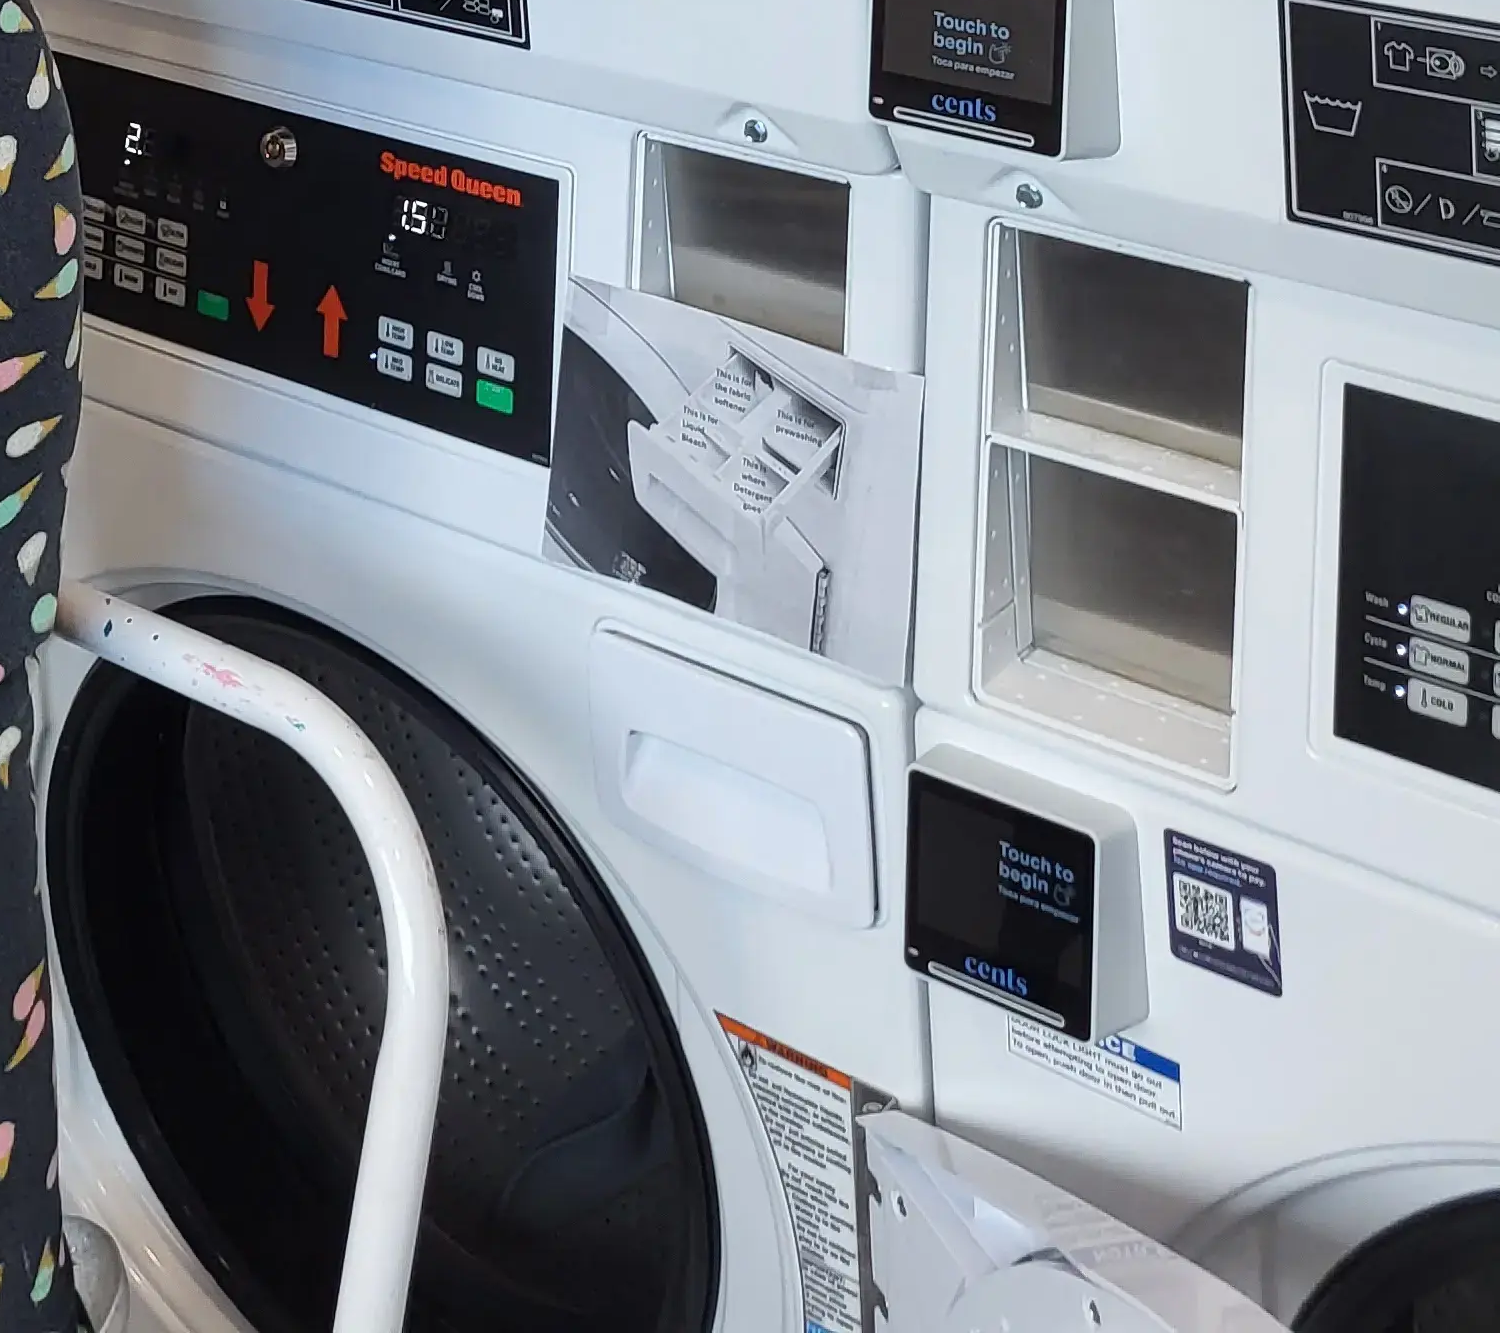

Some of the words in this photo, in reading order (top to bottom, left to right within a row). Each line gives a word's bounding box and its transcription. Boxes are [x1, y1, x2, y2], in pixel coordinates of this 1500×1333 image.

[933, 10, 987, 36] Touch
[989, 22, 1010, 40] to
[933, 30, 984, 56] begin
[931, 55, 953, 68] Toca
[954, 61, 975, 72] para
[975, 65, 1015, 80] empezar
[931, 94, 997, 122] cents
[380, 151, 448, 188] Speed
[451, 169, 522, 206] Queen
[716, 367, 732, 382] This
[733, 374, 740, 383] is
[741, 376, 752, 387] for
[715, 382, 728, 394] the
[728, 387, 751, 402] fabric
[714, 396, 746, 414] softener
[683, 405, 699, 419] This
[700, 410, 707, 420] is
[707, 413, 719, 426] for
[777, 409, 793, 423] This
[794, 414, 802, 424] is
[803, 416, 815, 428] for
[682, 419, 705, 434] Liquid
[775, 425, 823, 448] prewashing
[681, 433, 707, 450] Bleach
[742, 457, 759, 471] This
[760, 464, 767, 474] is
[741, 473, 766, 488] where
[733, 482, 773, 503] Detergent
[1365, 591, 1389, 608] Wash
[1430, 611, 1469, 631] REGULAR
[1364, 632, 1388, 649] Cycle
[1430, 654, 1465, 672] NORMAL
[1363, 673, 1387, 692] Temp
[1430, 696, 1454, 712] COLD
[999, 840, 1051, 875] Touch
[1055, 862, 1074, 883] to
[999, 860, 1048, 894] begin
[964, 956, 1028, 996] cents
